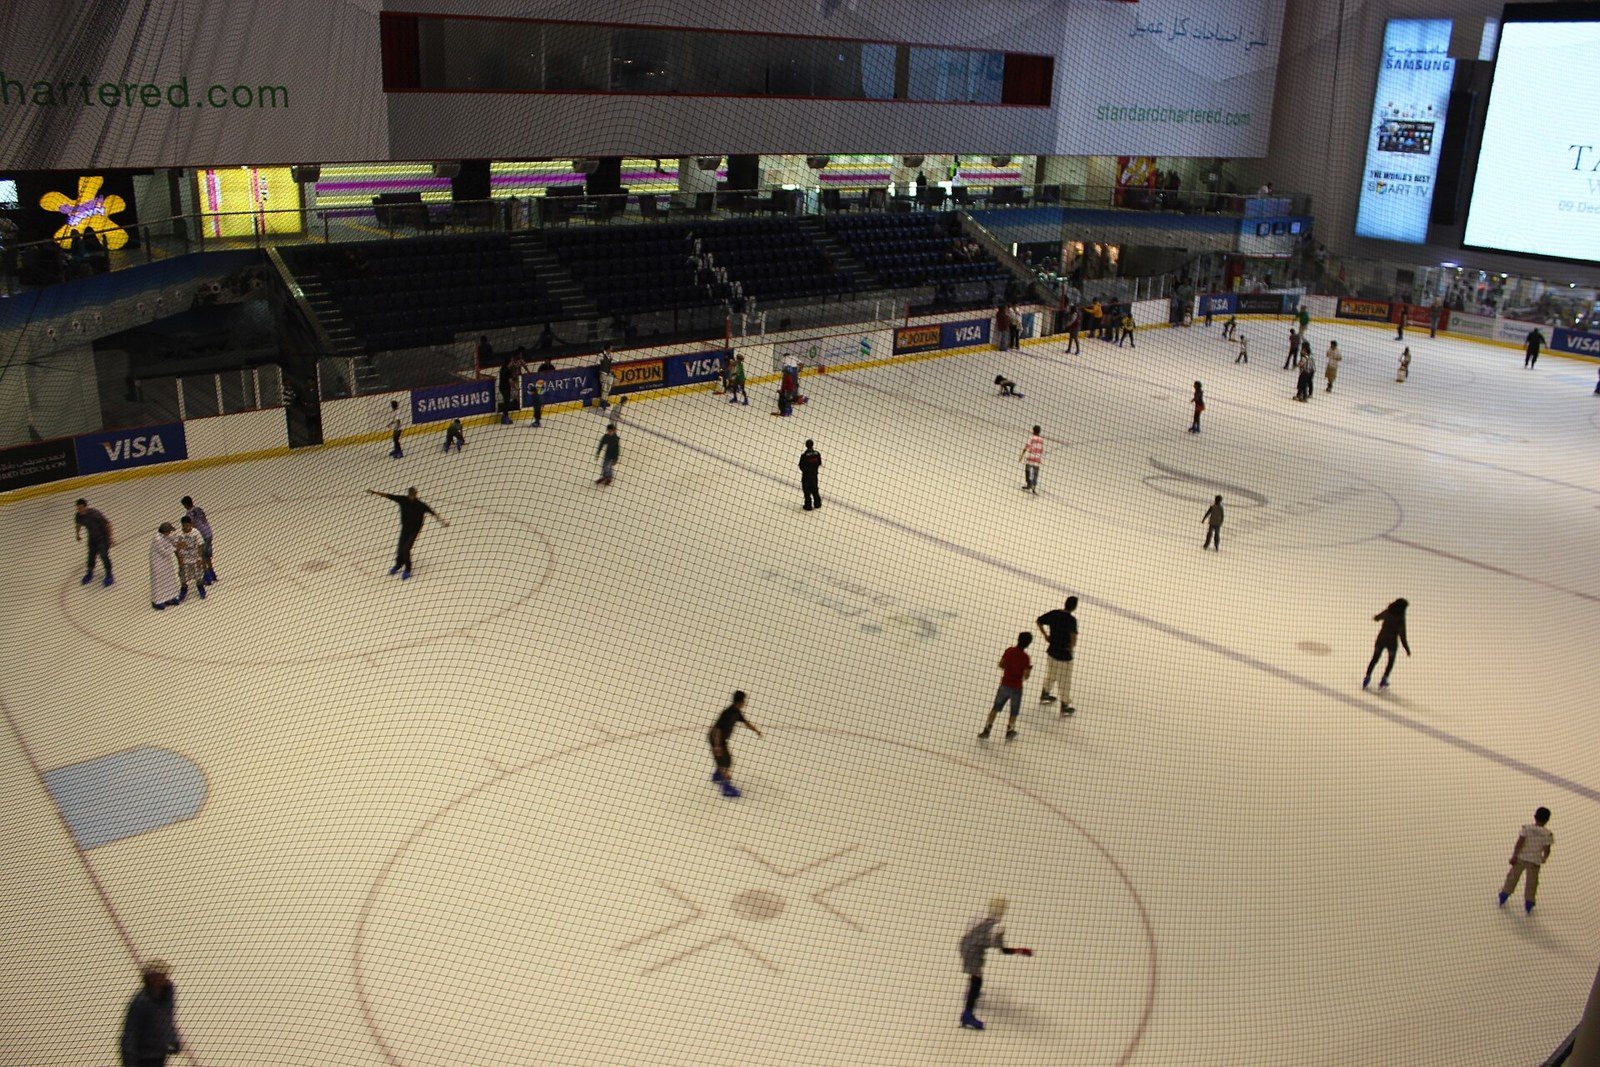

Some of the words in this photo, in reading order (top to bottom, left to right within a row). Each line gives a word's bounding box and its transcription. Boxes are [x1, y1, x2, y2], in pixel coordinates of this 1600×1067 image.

[1384, 58, 1451, 71] SAMSUNG
[0, 71, 290, 108] hartered.com
[1096, 103, 1252, 126] standardchartered.com
[1415, 185, 1429, 197] TV
[908, 327, 939, 345] JOTUN
[955, 325, 982, 342] VISA
[1567, 334, 1600, 353] VISA
[619, 365, 661, 383] JOTUN
[685, 357, 721, 378] VISA
[574, 376, 587, 388] TV
[416, 389, 491, 413] SAMSUNG
[102, 434, 165, 462] VISA
